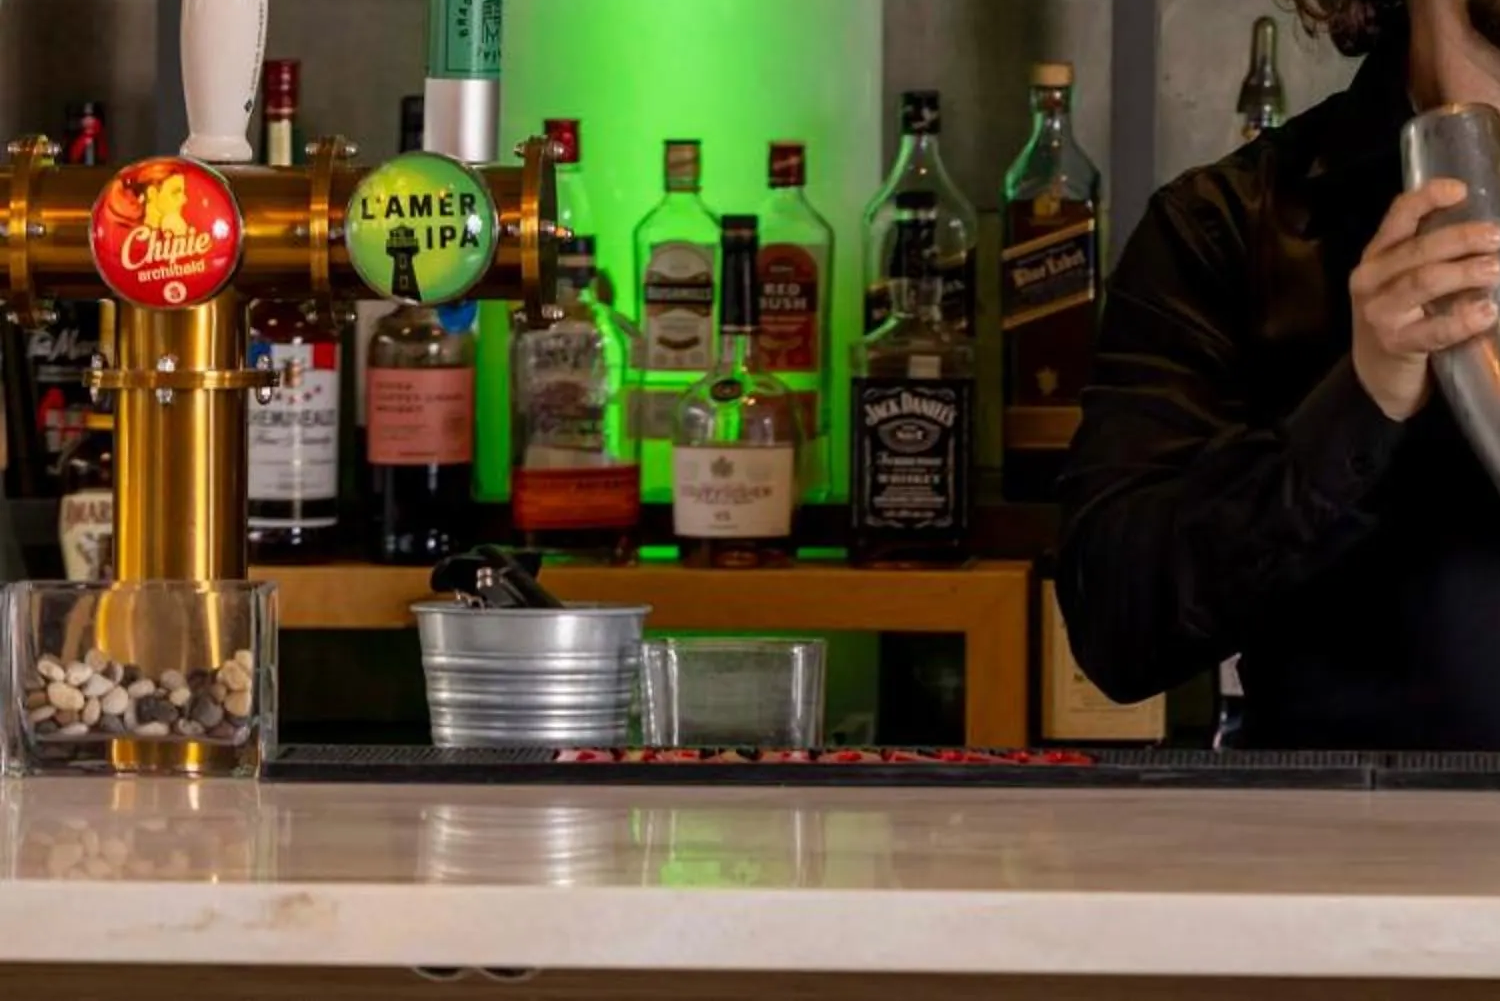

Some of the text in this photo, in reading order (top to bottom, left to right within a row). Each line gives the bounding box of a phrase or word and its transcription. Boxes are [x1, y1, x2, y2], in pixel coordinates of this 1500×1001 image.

[361, 192, 477, 220] L'AMER
[121, 225, 213, 271] Chipie
[426, 225, 480, 250] IPA
[137, 259, 206, 284] archibald
[863, 399, 900, 427] JACK
